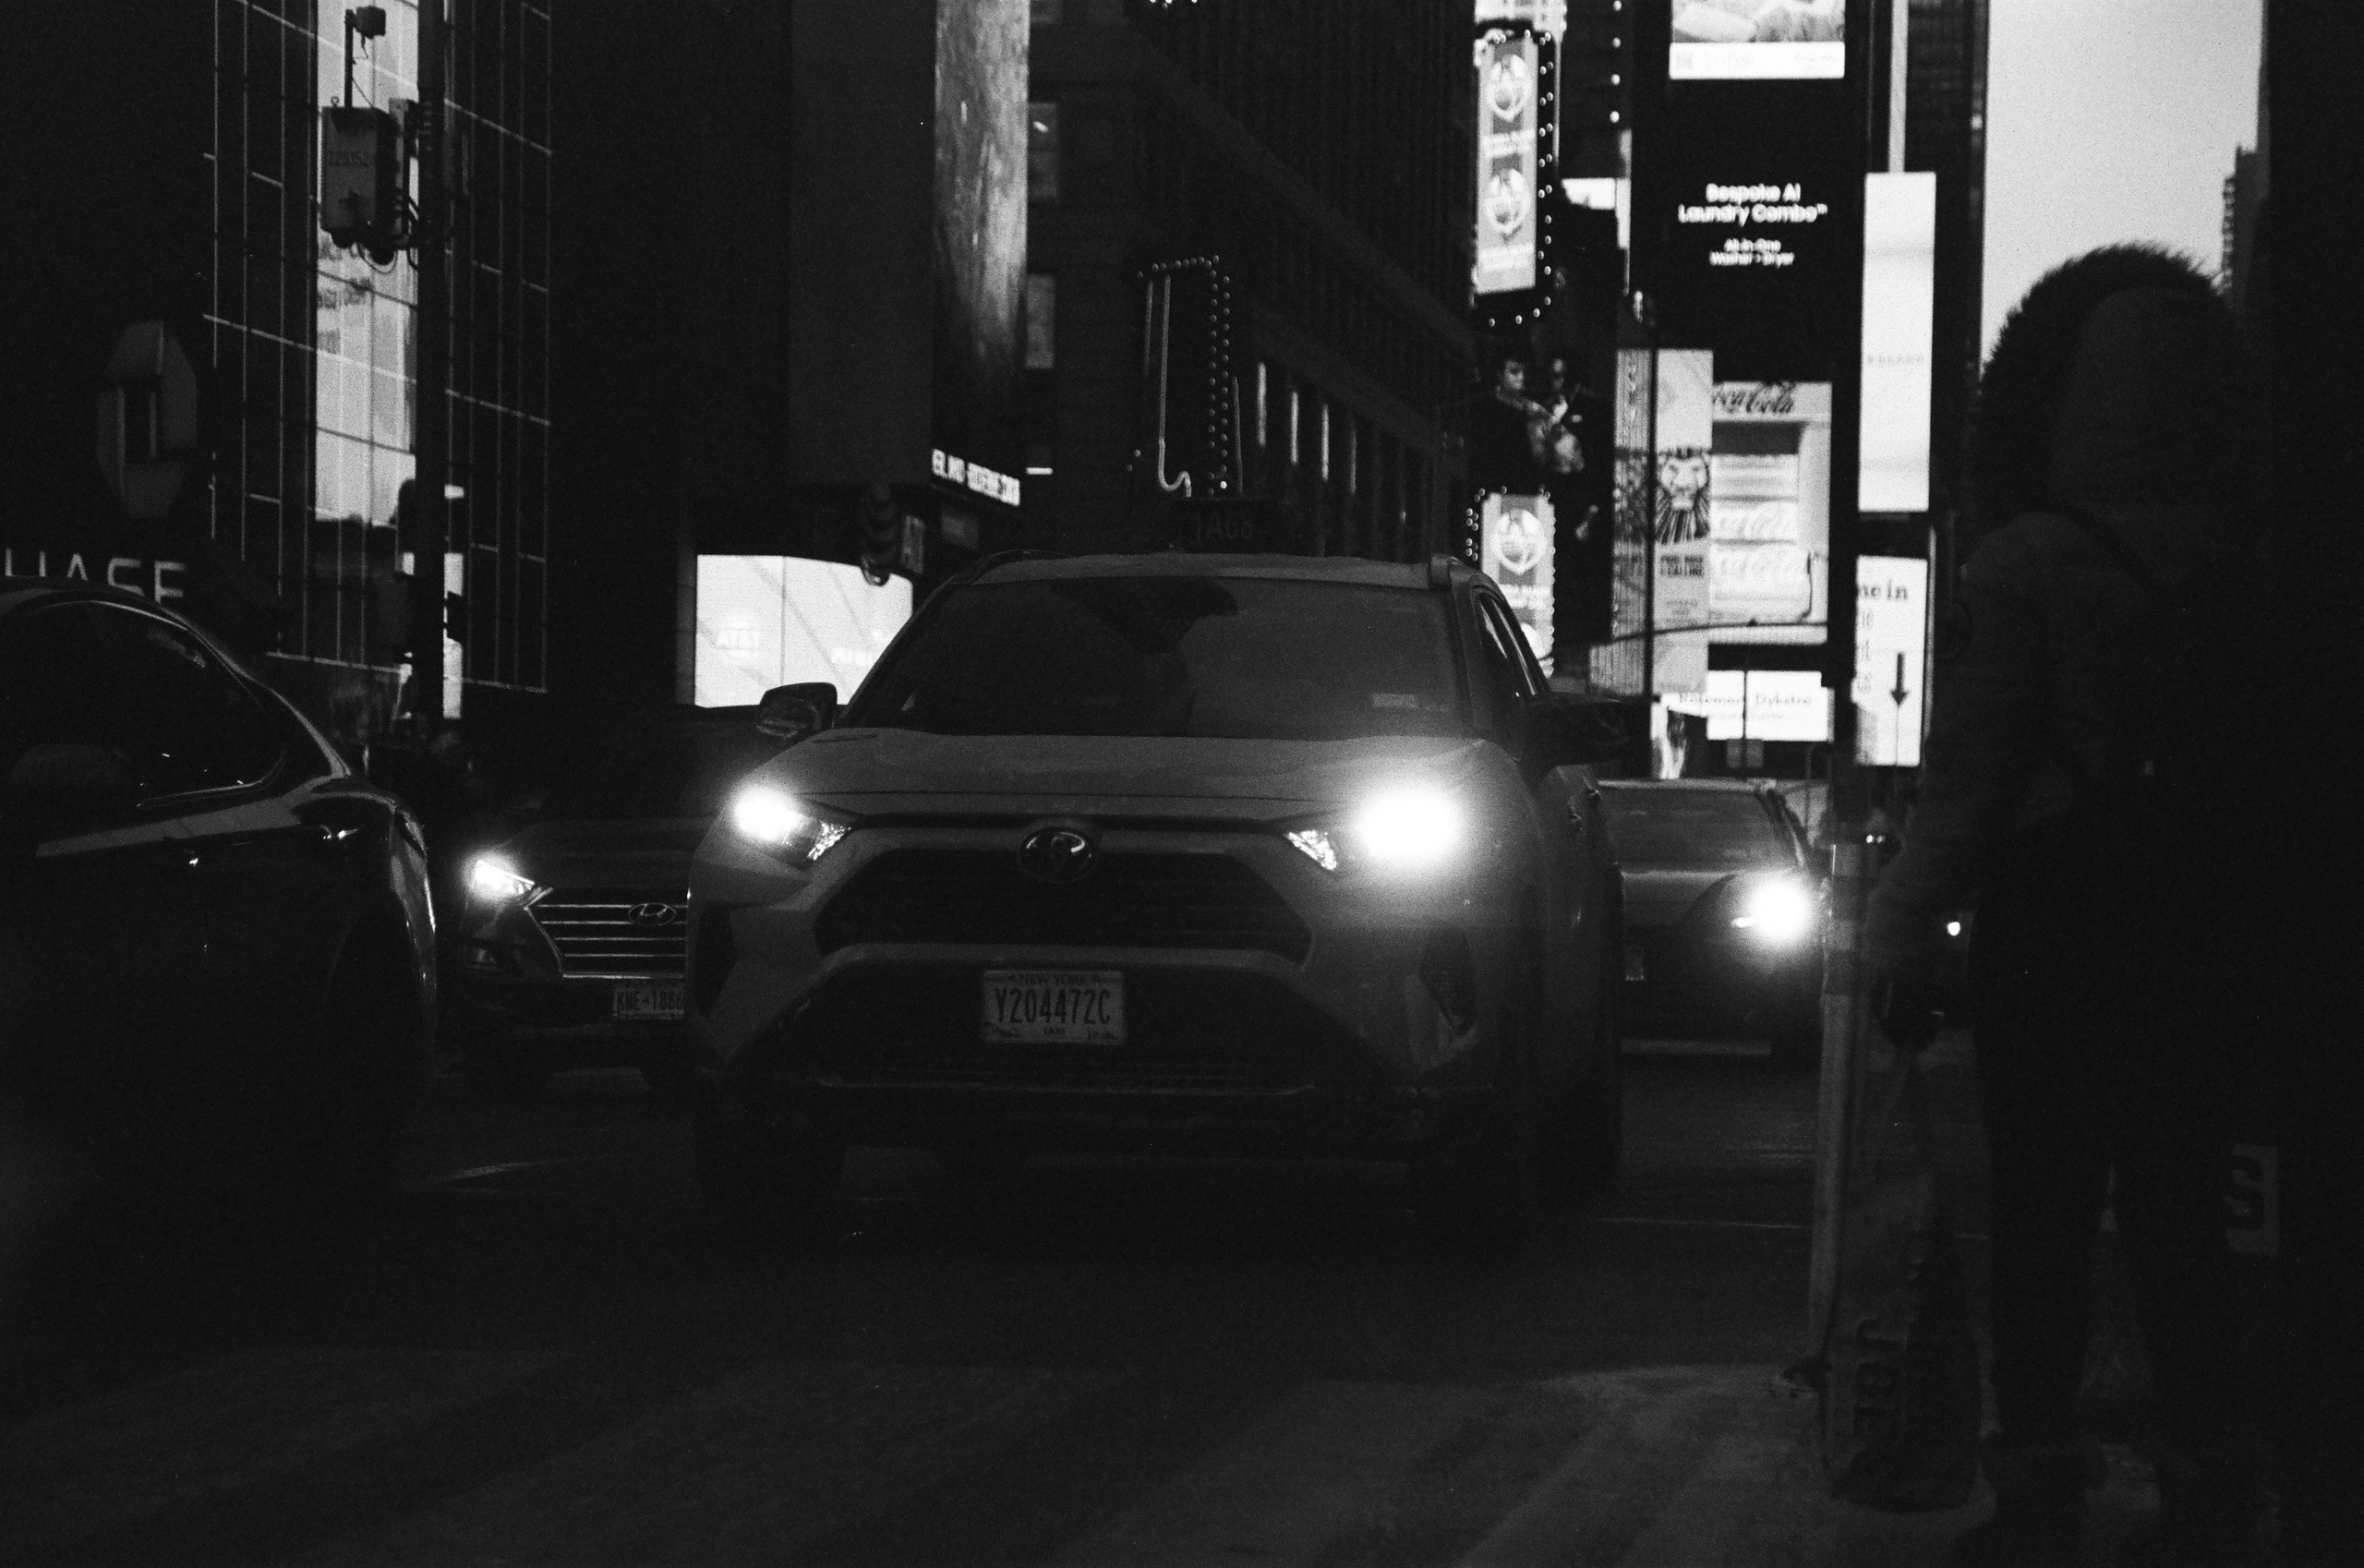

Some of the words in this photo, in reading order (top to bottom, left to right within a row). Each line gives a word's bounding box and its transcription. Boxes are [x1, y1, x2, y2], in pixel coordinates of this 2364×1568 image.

[1706, 183, 1780, 204] Bespoke
[1783, 183, 1801, 202] AI
[1678, 203, 1750, 227] Laundry
[995, 988, 1110, 1025] Y204472C
